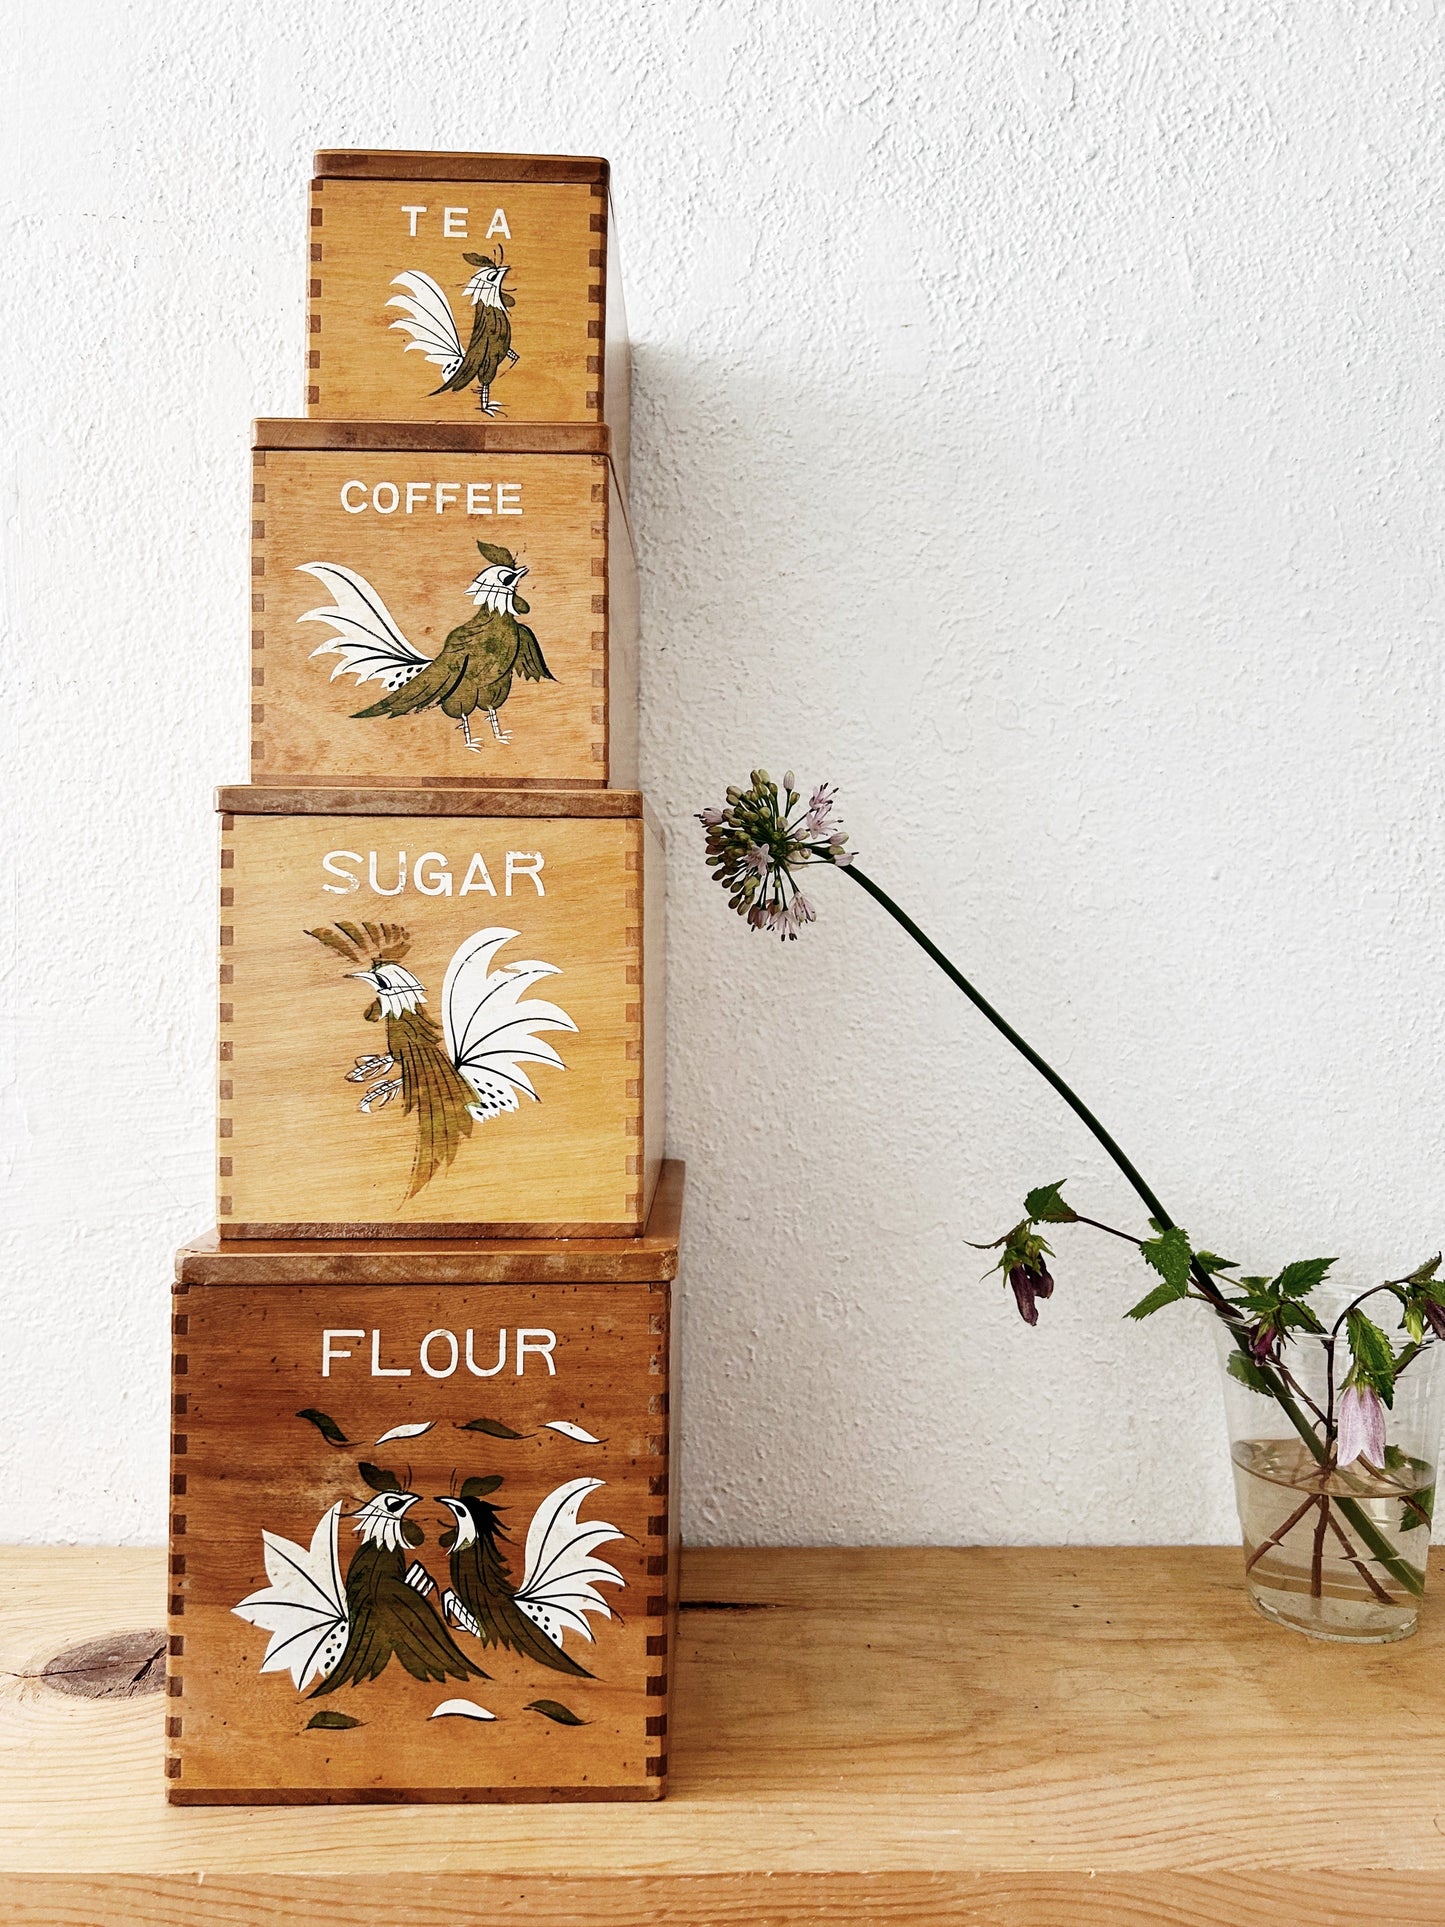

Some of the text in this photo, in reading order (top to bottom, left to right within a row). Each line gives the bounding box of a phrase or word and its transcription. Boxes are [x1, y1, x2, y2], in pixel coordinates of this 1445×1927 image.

[401, 206, 512, 240] TEA
[340, 480, 523, 515] COFFEE
[321, 850, 546, 897] SUGAR
[321, 1328, 557, 1378] FLOUR
